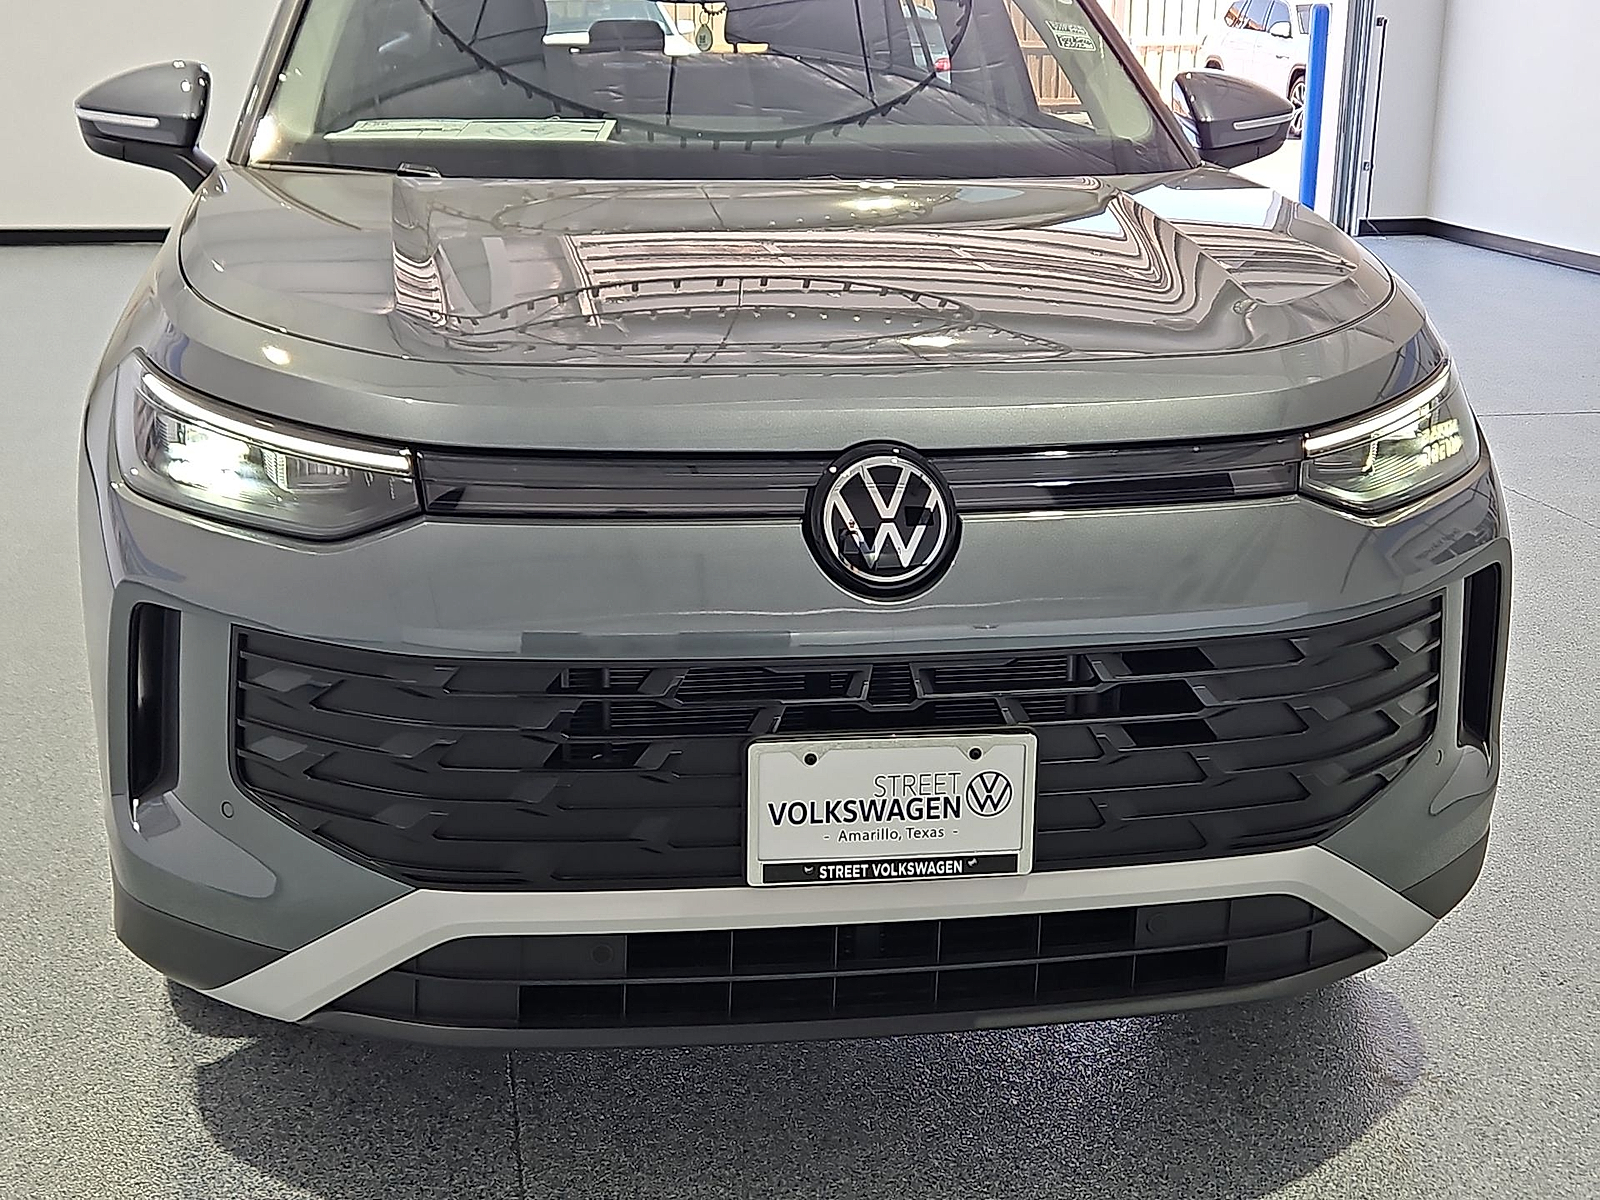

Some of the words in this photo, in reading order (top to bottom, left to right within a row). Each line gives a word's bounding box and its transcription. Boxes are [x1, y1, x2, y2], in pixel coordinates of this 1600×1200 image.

[873, 772, 961, 798] STREET
[768, 796, 961, 826] VOLKSWAGEN
[837, 828, 903, 842] Amarillo,
[905, 827, 945, 840] Texas
[819, 863, 867, 879] STREET
[871, 859, 963, 878] VOLKSWAGEN
